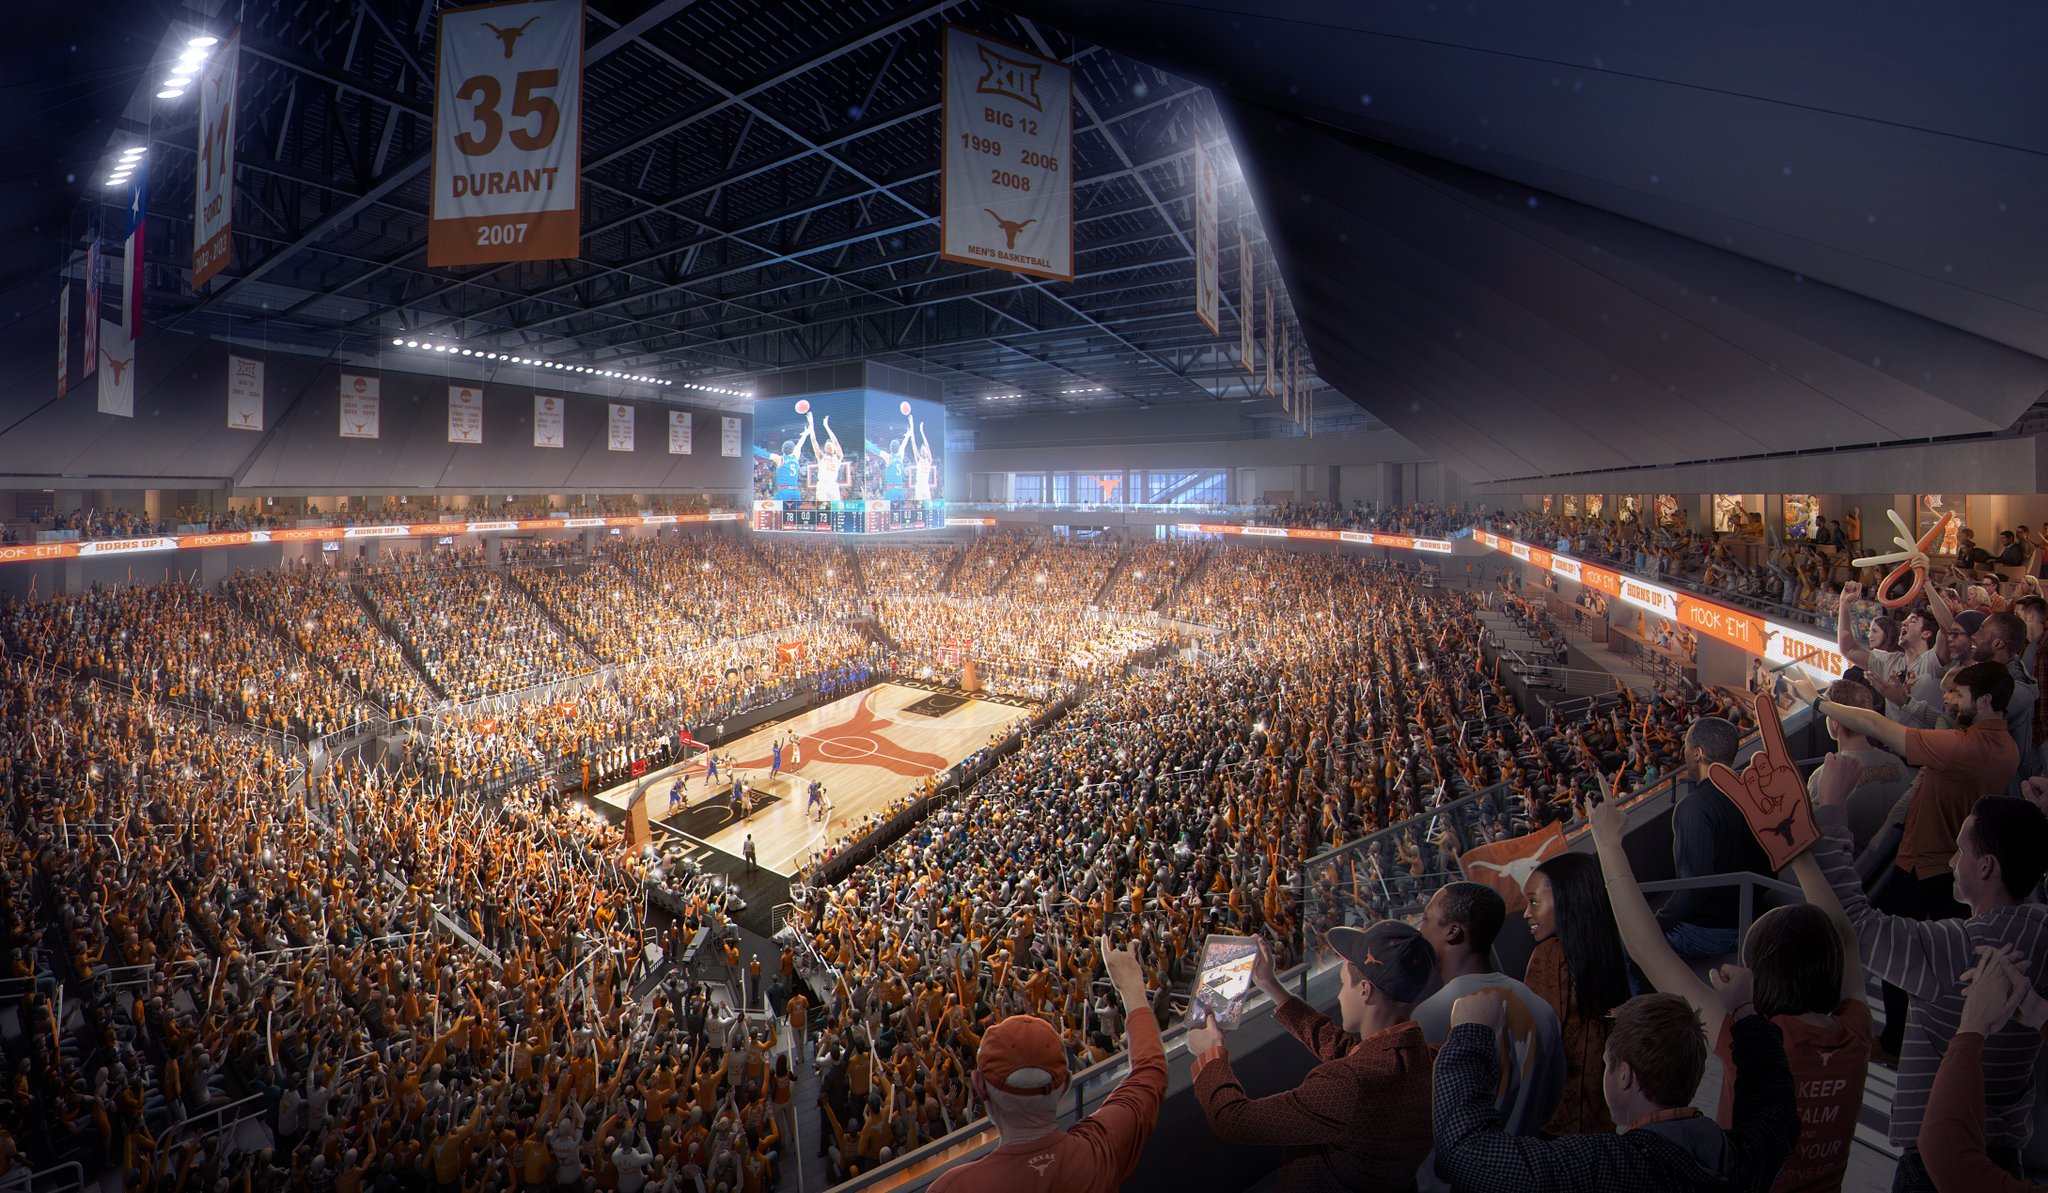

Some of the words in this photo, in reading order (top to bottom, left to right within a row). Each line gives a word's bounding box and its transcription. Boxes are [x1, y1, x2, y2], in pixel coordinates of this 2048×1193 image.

[454, 68, 560, 157] 35
[984, 106, 1014, 129] BIG
[1019, 117, 1038, 136] 12
[201, 102, 228, 192] 11
[961, 133, 1001, 157] 1999
[1021, 150, 1059, 172] 2006
[453, 167, 559, 198] DURANT
[991, 169, 1031, 192] 2008
[477, 223, 528, 246] 2007
[968, 244, 996, 259] MEN'S
[998, 250, 1052, 269] BASKETBALL
[789, 463, 797, 477] 5
[95, 541, 138, 551] HORNS
[1627, 583, 1650, 603] HORNS
[1691, 604, 1721, 629] HOOK
[1783, 636, 1843, 677] HORNS
[1798, 1079, 1847, 1098] KEEP
[1796, 1105, 1840, 1124] ALM
[1027, 1153, 1056, 1165] TEXAS
[1800, 1139, 1842, 1161] YOUR
